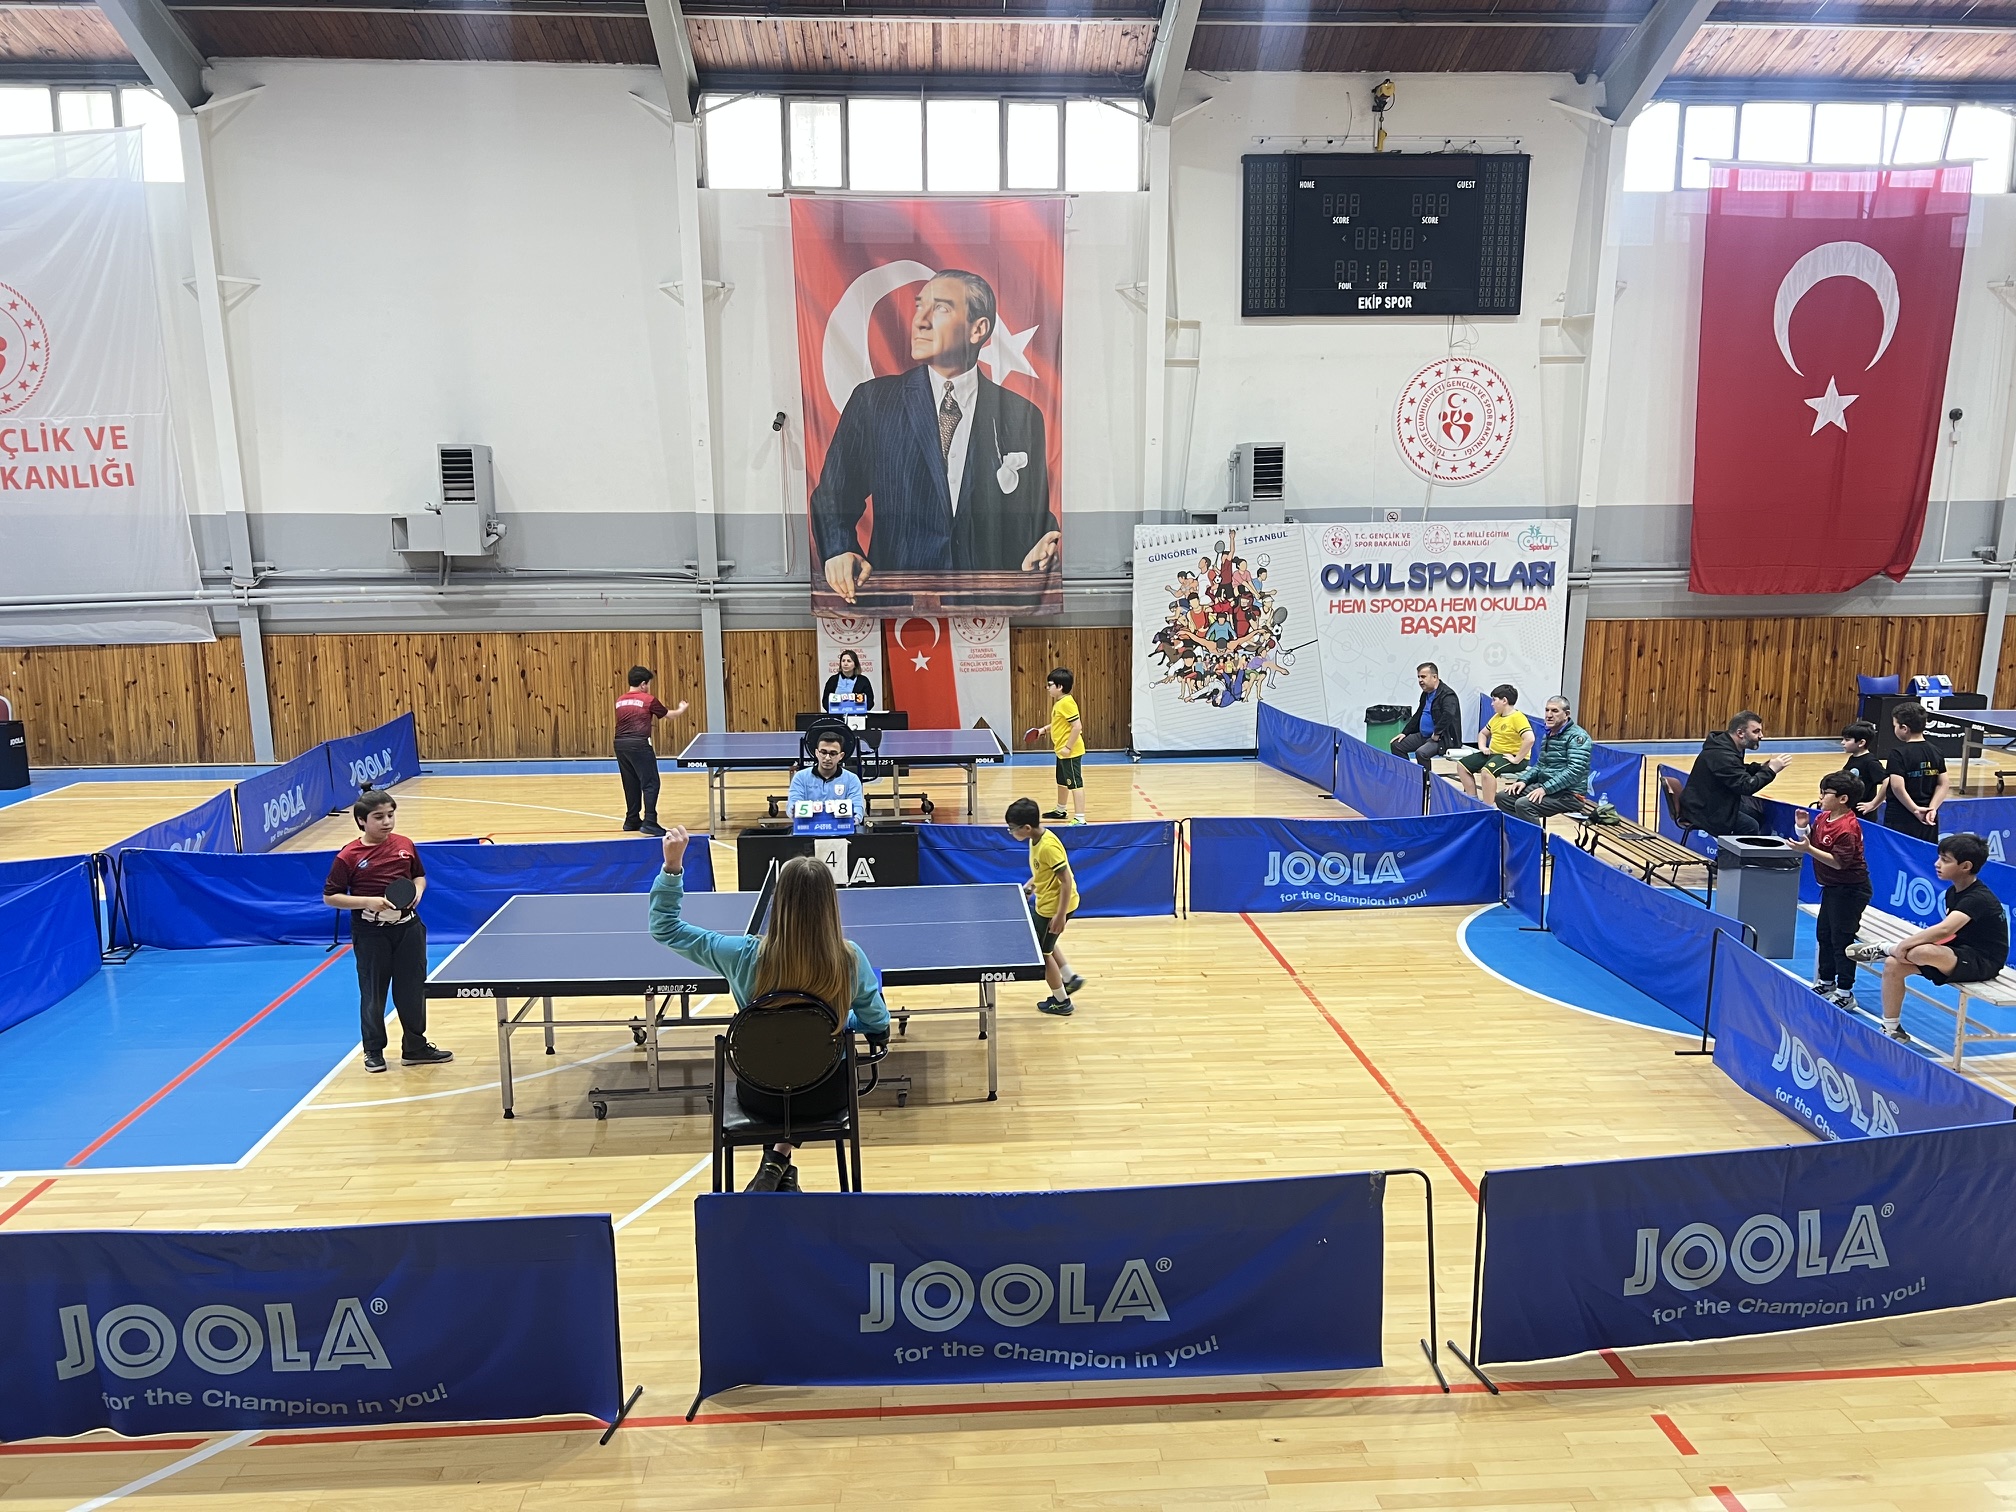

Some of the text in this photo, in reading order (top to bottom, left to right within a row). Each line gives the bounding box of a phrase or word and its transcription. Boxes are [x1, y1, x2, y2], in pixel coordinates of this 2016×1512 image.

[1299, 181, 1315, 189] HOME
[1457, 180, 1476, 189] GUEST
[1332, 216, 1350, 224] SCORE
[1421, 216, 1439, 224] SCORE
[1338, 282, 1352, 290] FOUL
[1378, 282, 1388, 290] SET
[1413, 281, 1427, 290] FOUL
[1357, 294, 1412, 309] EKİP SPOR
[1446, 380, 1478, 392] GENÇLİK
[1477, 389, 1486, 400] VE
[1483, 400, 1494, 420] SPOR
[83, 426, 129, 451] VE
[1464, 421, 1494, 456] BAKANLIĞI
[1243, 531, 1289, 545] İSTANBUL
[1369, 532, 1400, 541] GENÇLİK
[1523, 535, 1559, 547] OKUL
[1374, 539, 1411, 547] BAKANLIĞI
[1148, 547, 1198, 563] GÜNGÖREN
[1320, 561, 1556, 592] OKUL SPORLARI
[1329, 596, 1547, 614] HEM SPORDA HEM OKULDA
[1400, 616, 1476, 637] BAŞARI
[856, 694, 864, 702] 3
[799, 804, 809, 815] 5
[838, 803, 848, 814] 8
[825, 851, 838, 868] 4
[1280, 888, 1427, 906] for the Champion in you!
[981, 972, 1016, 982] JOOLA
[456, 987, 494, 998] JOOLA
[685, 984, 698, 993] 25
[1775, 1087, 1812, 1119] for the
[1652, 1276, 1927, 1326] for the Champion in you!
[893, 1335, 1220, 1370] for the Champion in you!
[101, 1382, 448, 1417] for the Champion in you!
